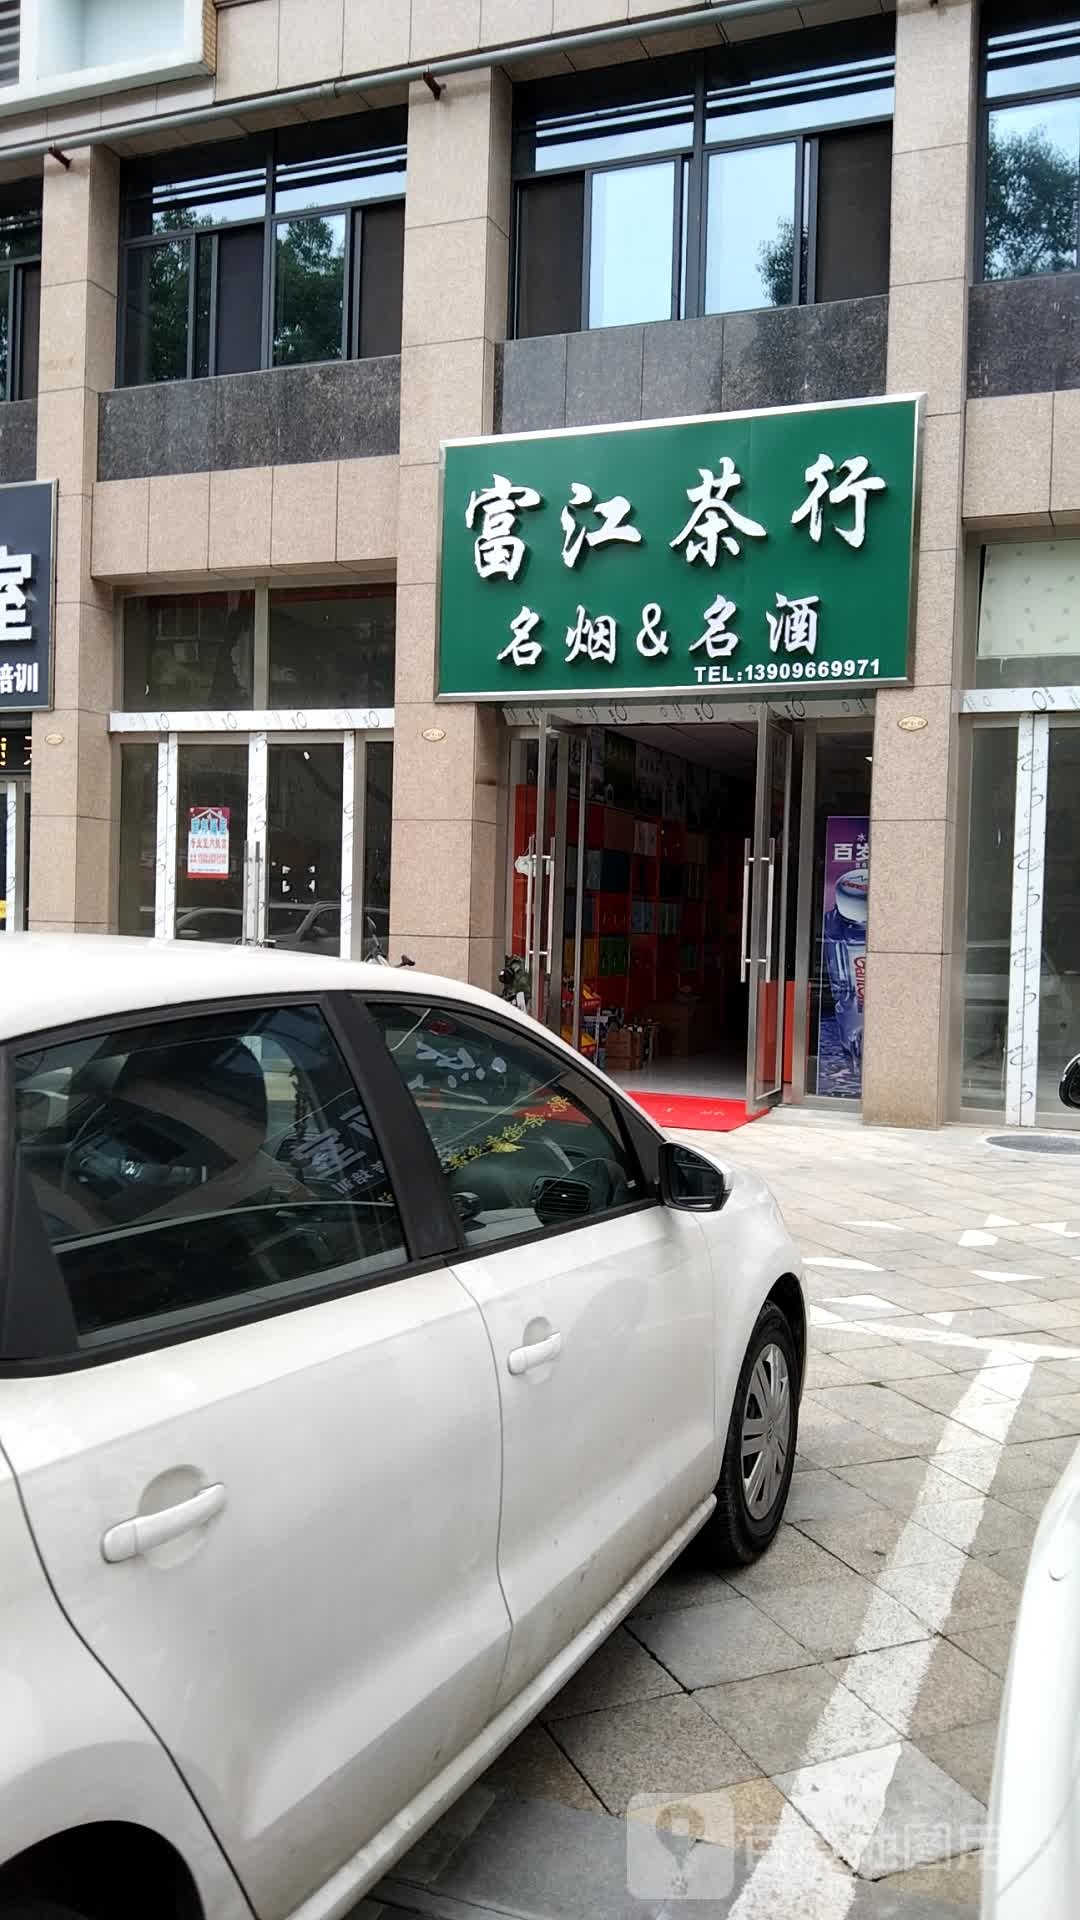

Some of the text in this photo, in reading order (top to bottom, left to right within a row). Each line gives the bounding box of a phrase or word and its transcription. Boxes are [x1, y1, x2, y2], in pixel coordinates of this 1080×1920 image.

[465, 453, 886, 582] 富江茶行
[497, 591, 821, 668] 名烟&名酒
[693, 658, 880, 683] TEL:13909669971
